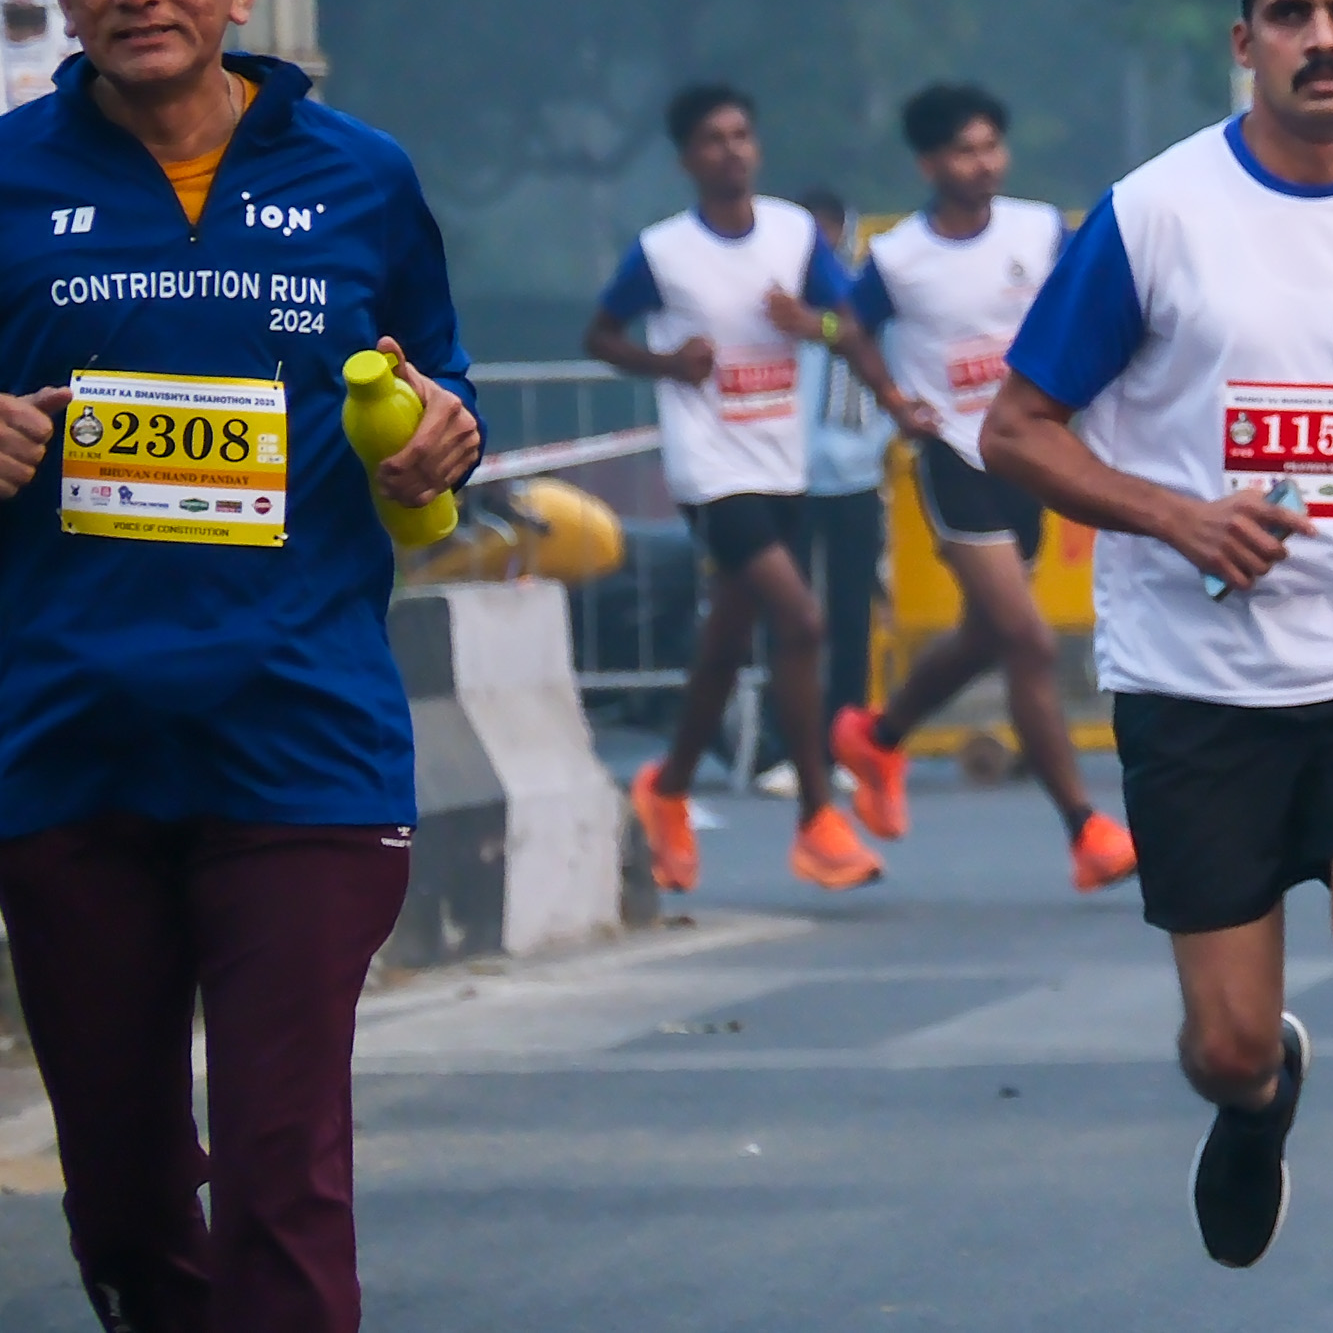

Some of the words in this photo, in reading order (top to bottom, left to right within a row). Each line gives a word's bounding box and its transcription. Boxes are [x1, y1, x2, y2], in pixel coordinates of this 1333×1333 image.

[51, 270, 260, 306] CONTRIBUTION
[270, 274, 327, 305] RUN
[269, 308, 326, 334] 2024
[79, 386, 117, 397] BHARAT
[119, 389, 132, 398] KA
[134, 390, 190, 402] BHAVISHYA
[254, 398, 276, 407] 2025
[108, 411, 250, 463] 2308
[153, 471, 198, 483] CHAND
[201, 474, 250, 486] PANDAY
[113, 521, 141, 532] VOICE
[143, 523, 156, 532] OF
[157, 524, 230, 537] CONSTITUTION
